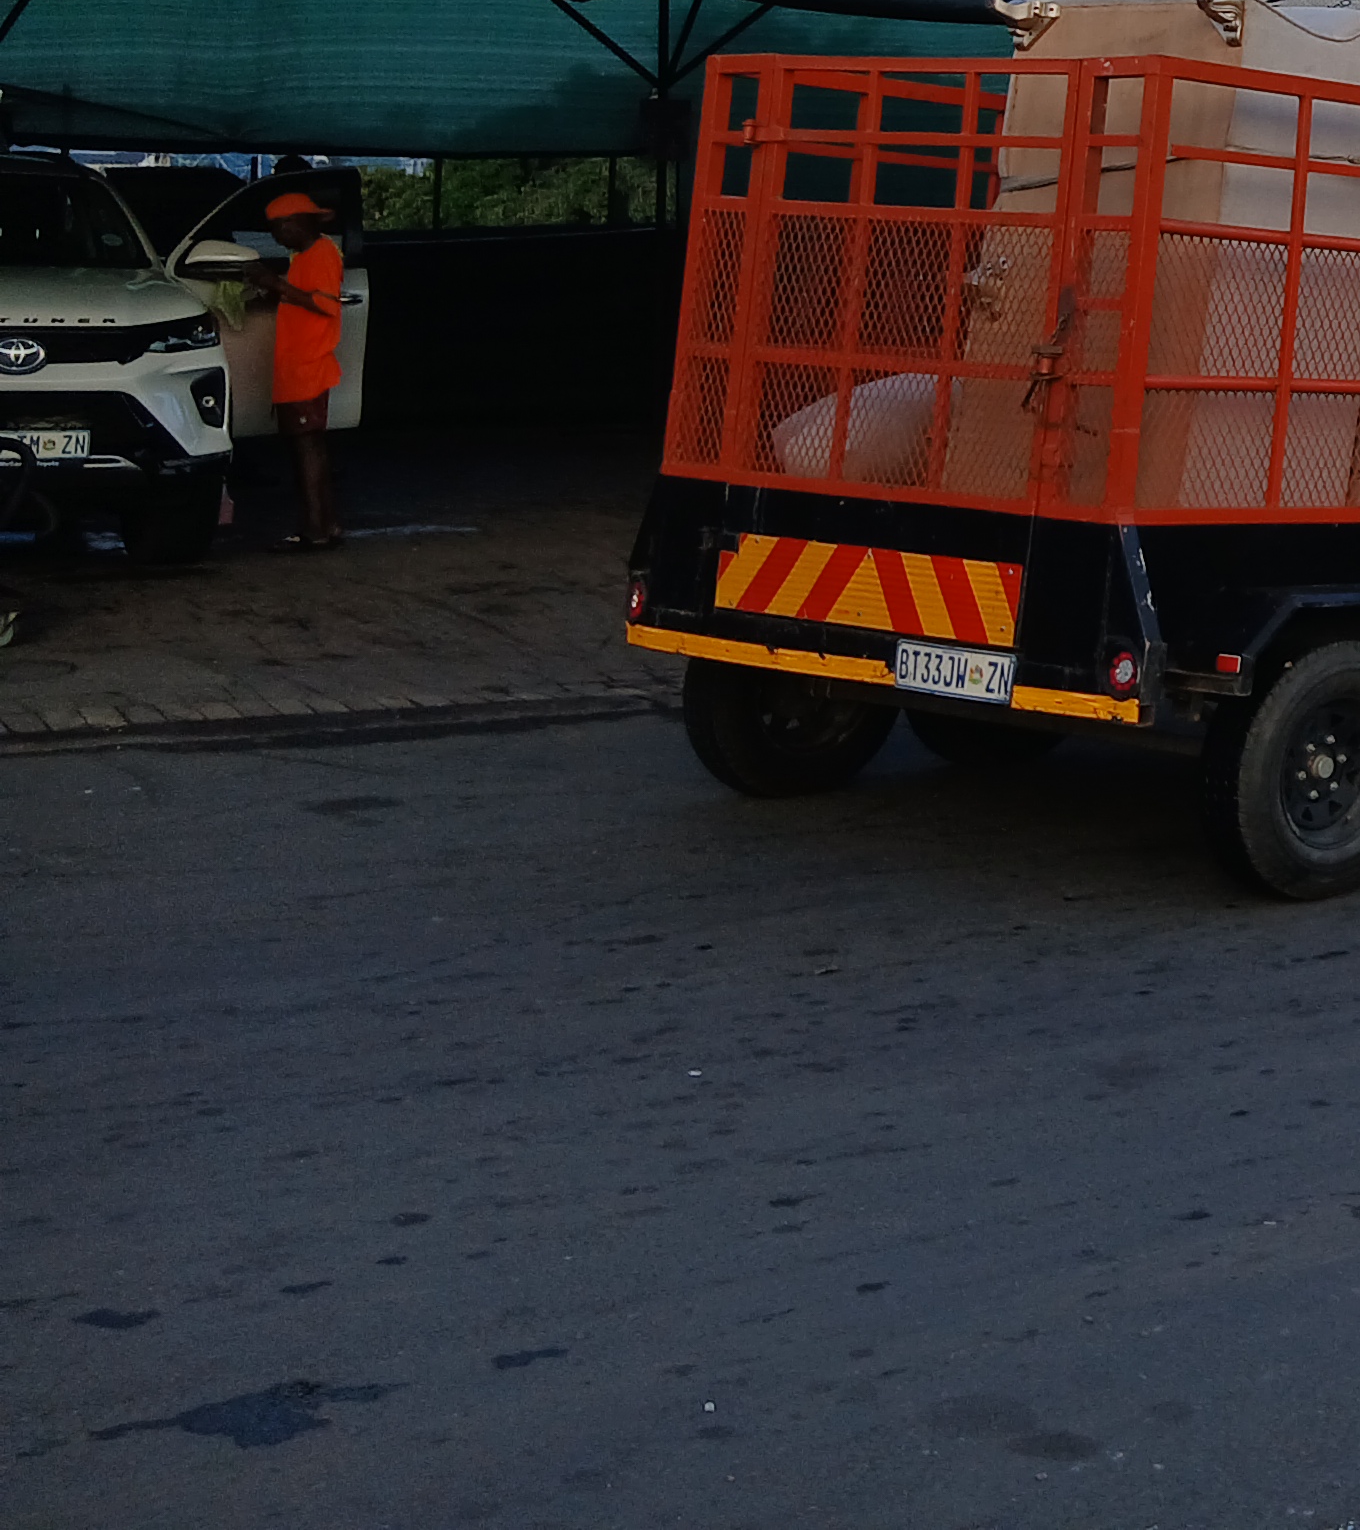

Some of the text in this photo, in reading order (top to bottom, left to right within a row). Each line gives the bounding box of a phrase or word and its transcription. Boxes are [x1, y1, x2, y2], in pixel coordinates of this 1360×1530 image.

[61, 434, 86, 455] ZN
[899, 648, 1011, 695] BT33JW ZN
